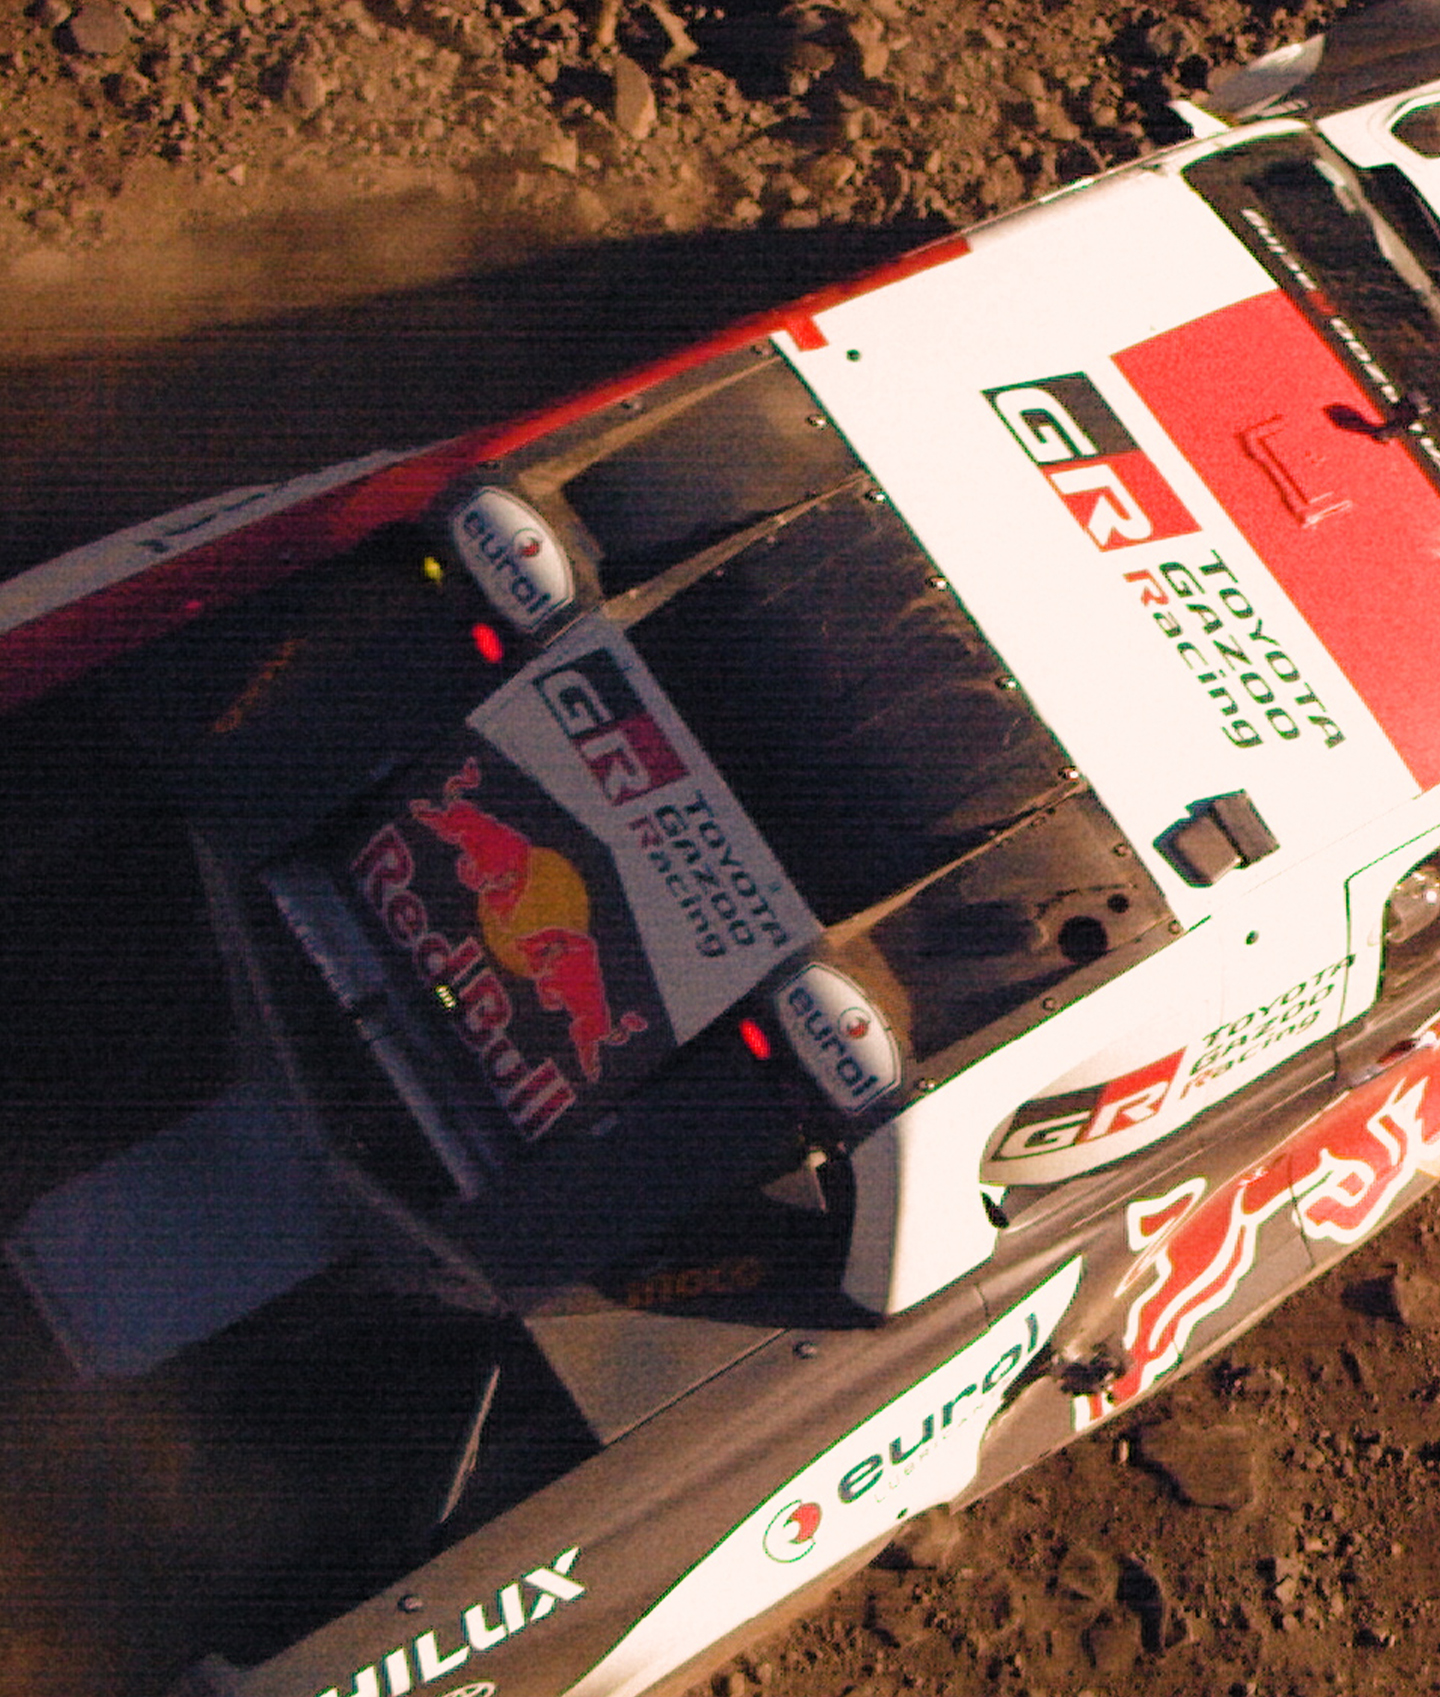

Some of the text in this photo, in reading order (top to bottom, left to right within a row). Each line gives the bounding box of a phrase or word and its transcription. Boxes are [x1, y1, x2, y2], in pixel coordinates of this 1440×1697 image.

[1330, 316, 1424, 434] AZOO
[991, 384, 1156, 550] GR
[463, 510, 552, 615] eurol
[1122, 569, 1264, 749] Racing
[1159, 561, 1300, 741] GAZOO
[1197, 549, 1346, 749] TOYOTA
[540, 667, 653, 803] GR
[627, 815, 728, 958] Racing
[656, 804, 757, 947] GAZOO
[684, 789, 790, 948] TOYOTA
[349, 824, 577, 1142] Red Bull
[789, 985, 879, 1098] eurol
[1190, 983, 1335, 1077] GAZOO
[1202, 954, 1356, 1047] TOYOTA
[993, 1078, 1173, 1158] GR
[1180, 1009, 1322, 1101] Racing
[837, 1311, 1040, 1504] eurol
